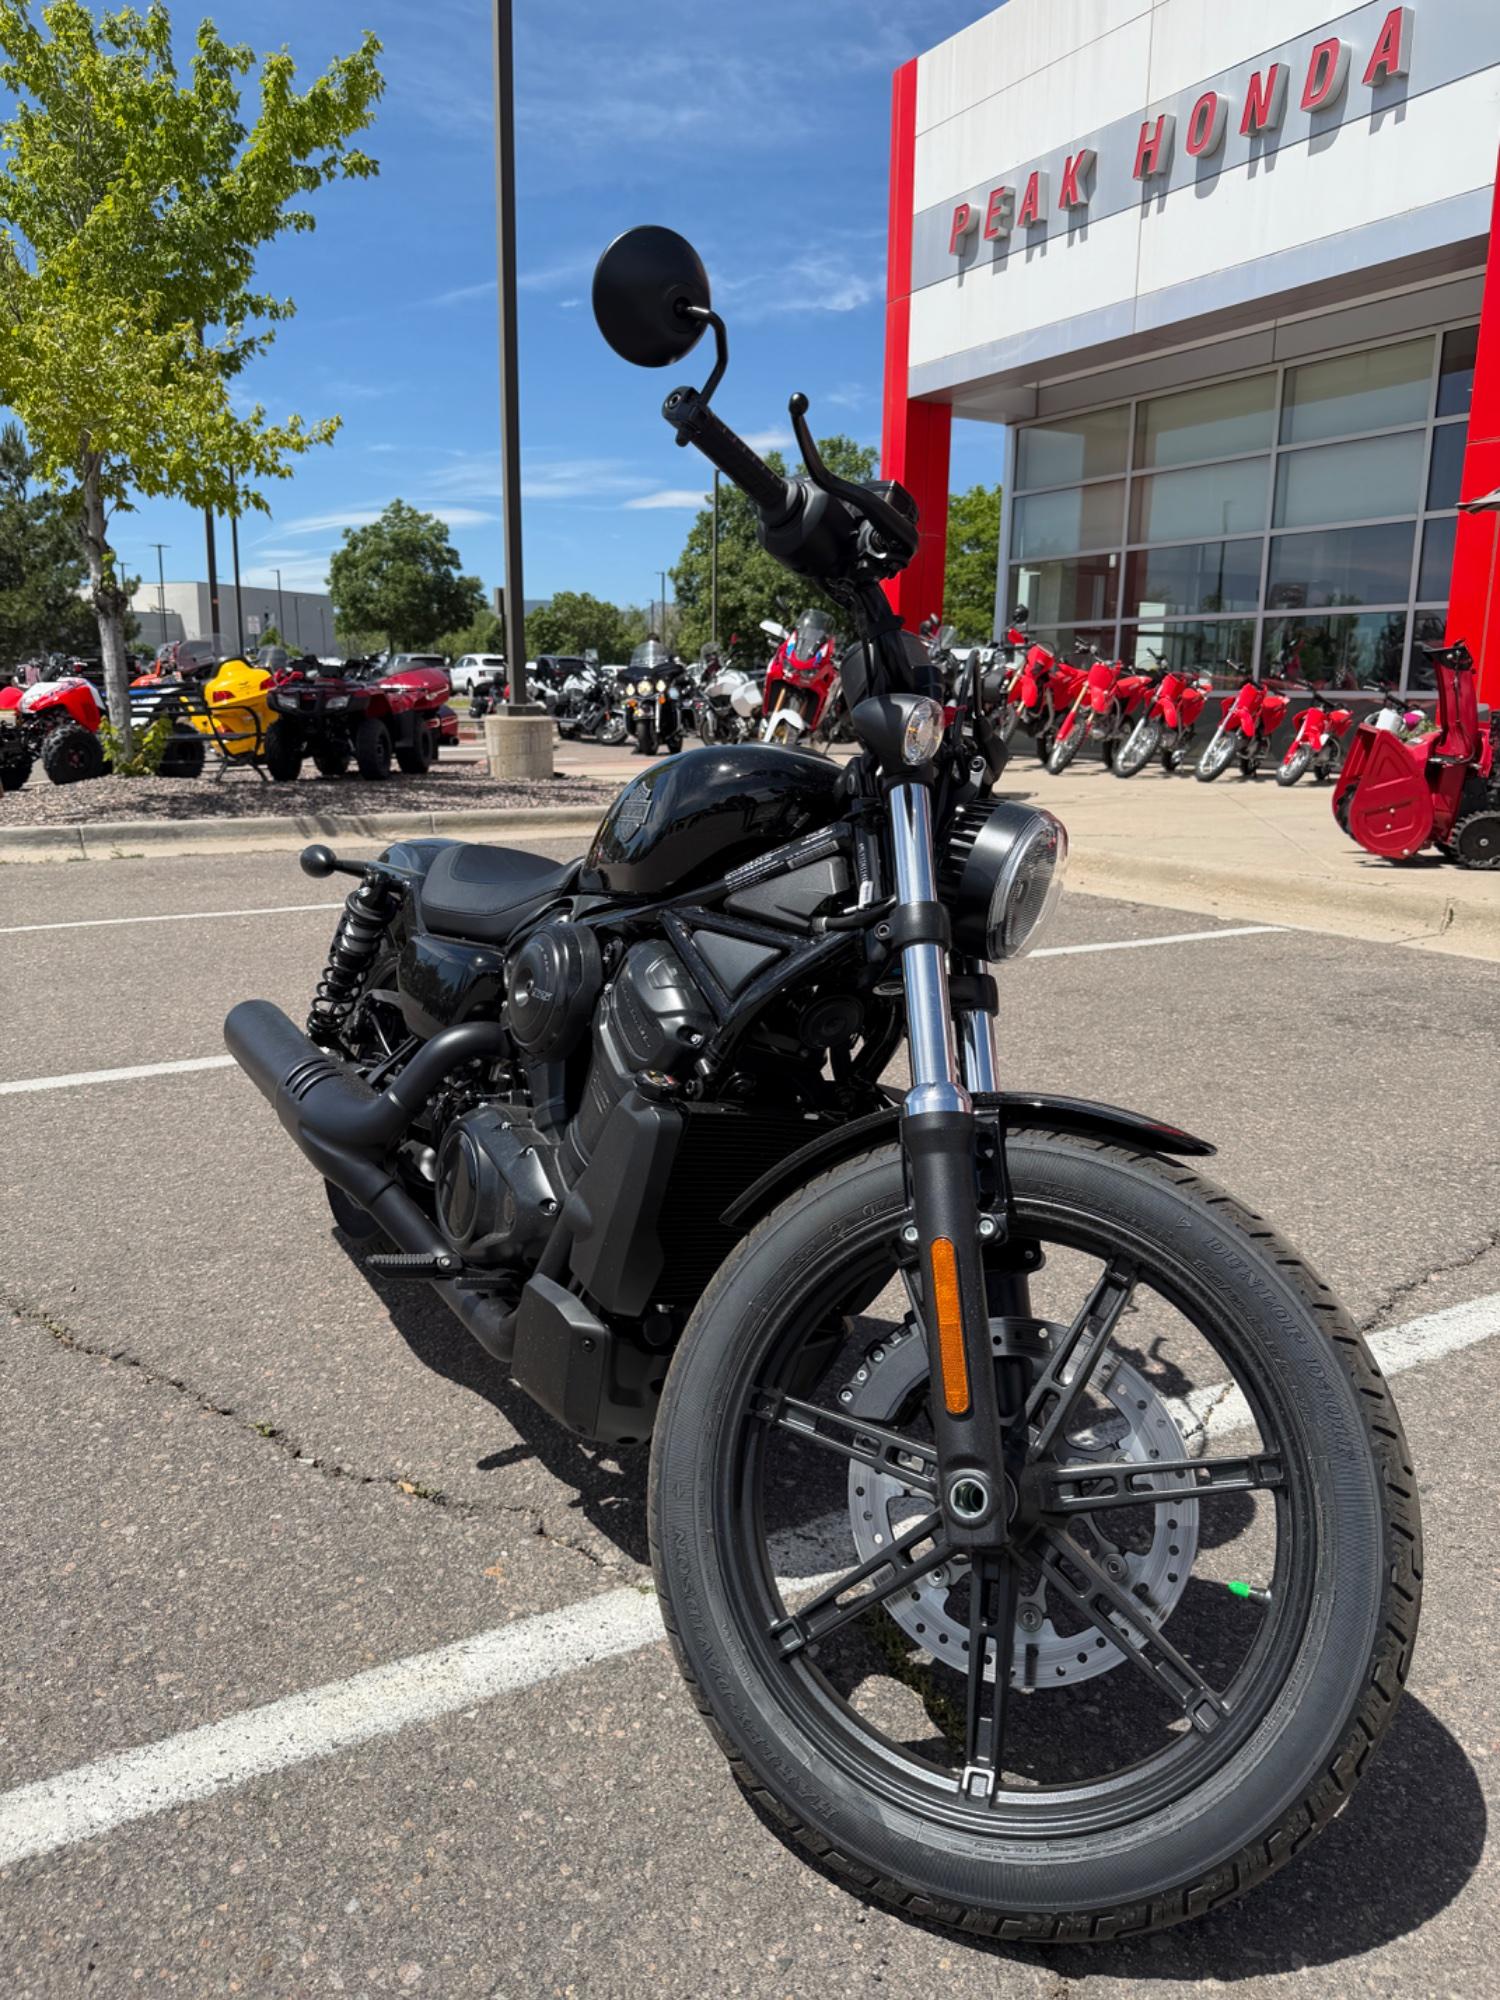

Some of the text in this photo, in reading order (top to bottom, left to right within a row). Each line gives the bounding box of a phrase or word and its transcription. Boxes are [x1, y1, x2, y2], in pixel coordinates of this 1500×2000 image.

[949, 6, 1410, 255] PEAK HONDA
[1202, 1233, 1308, 1348] DUNLOP
